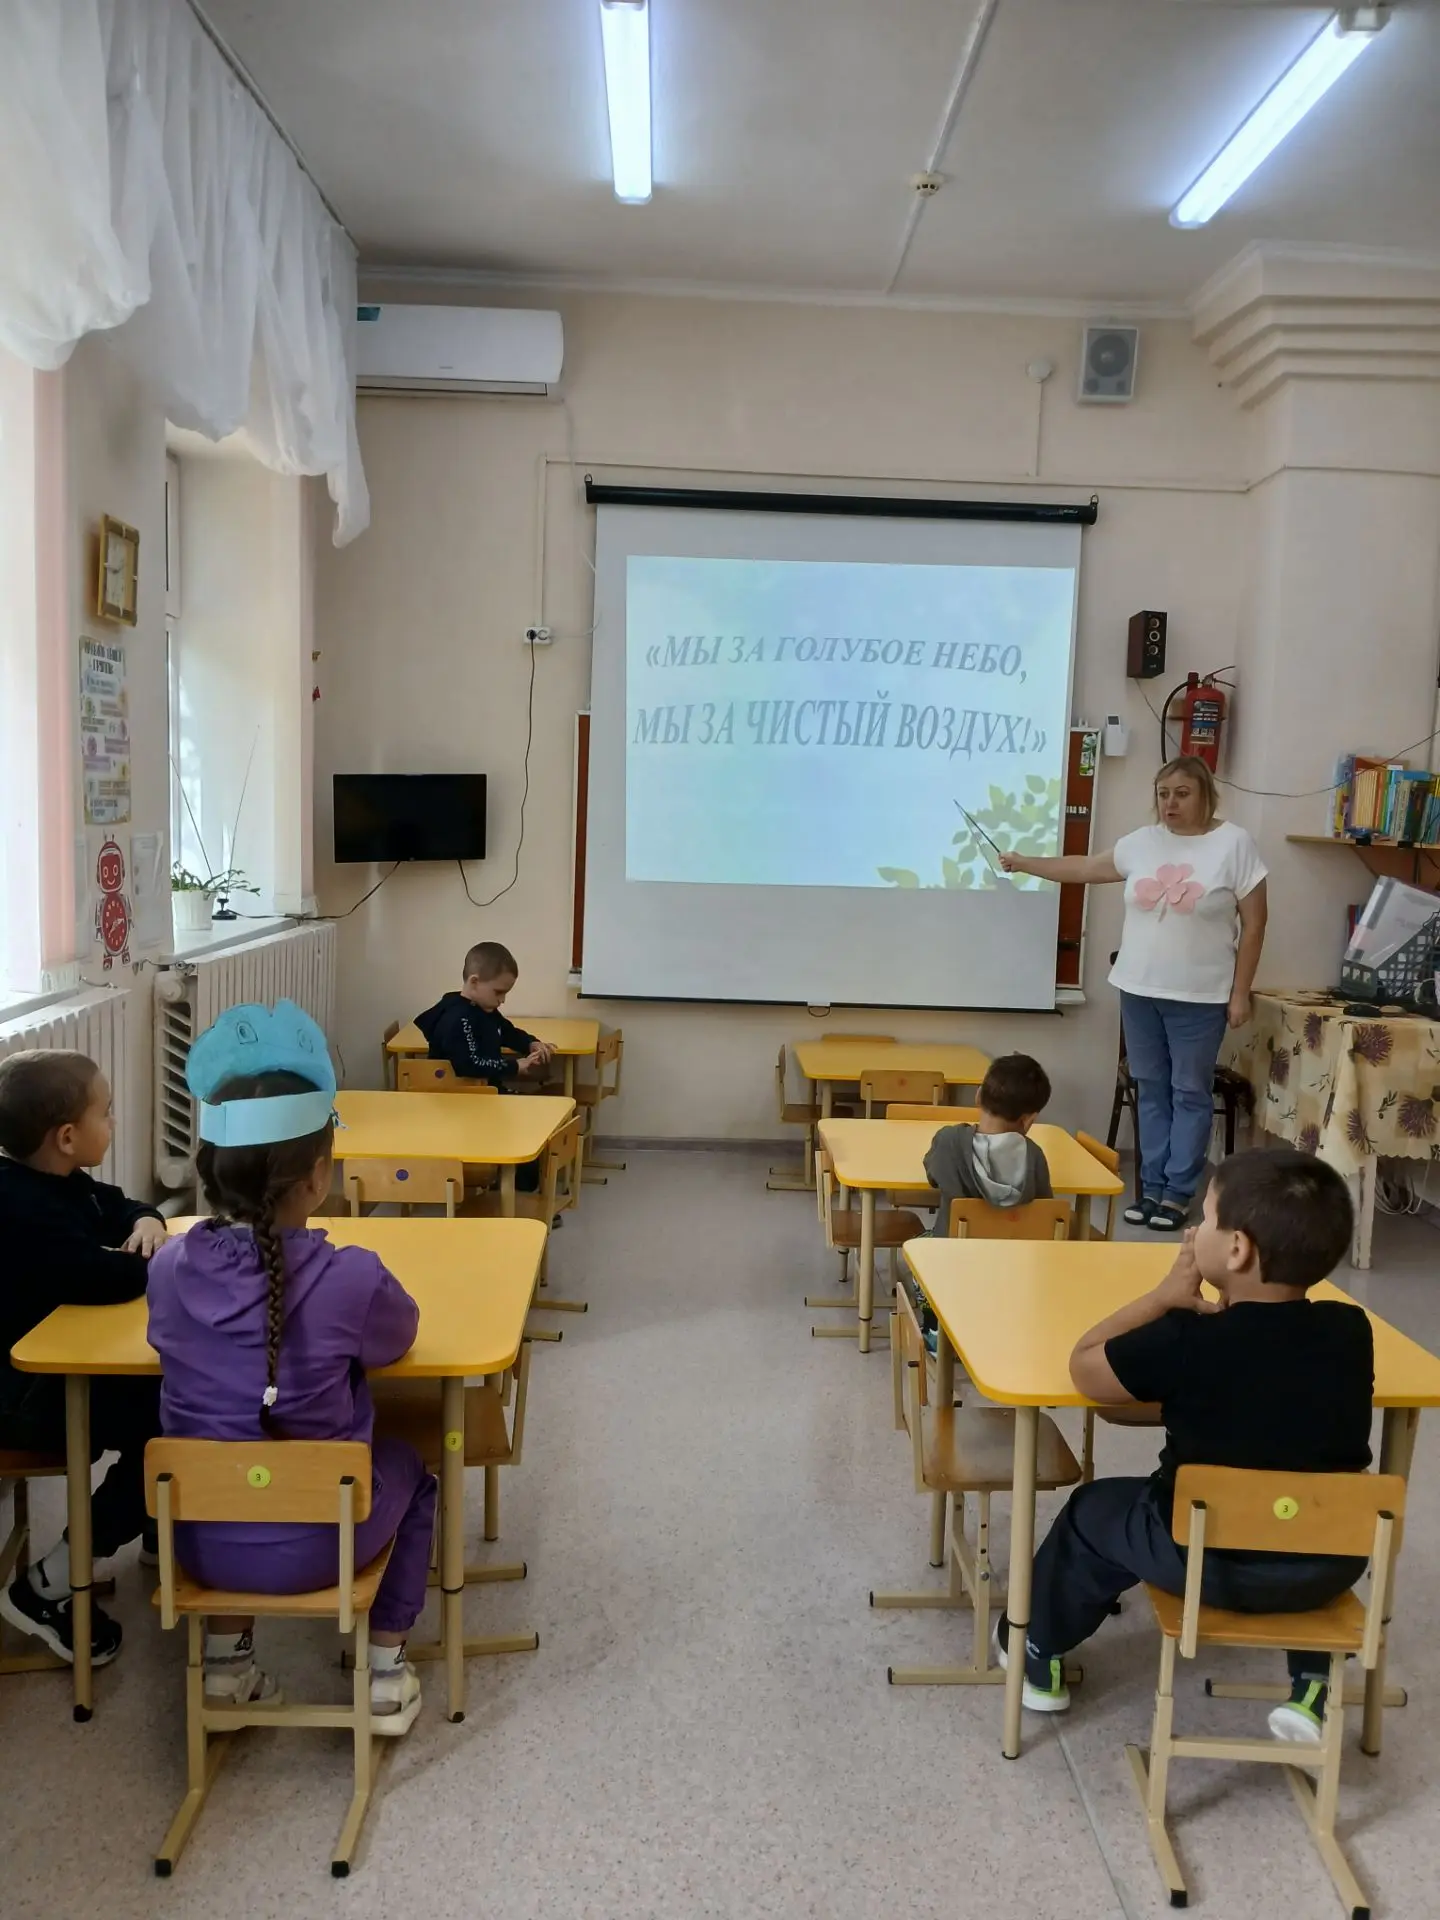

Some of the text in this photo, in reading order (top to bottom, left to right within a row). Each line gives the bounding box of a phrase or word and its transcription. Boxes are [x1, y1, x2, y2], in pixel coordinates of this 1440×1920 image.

[645, 635, 1028, 685] «МЫ ЗА ГОЛУБОЕ НЕБО,
[632, 689, 1047, 762] МЫ ЗА ЧИСТЫЙ ВОЗДУХ!»
